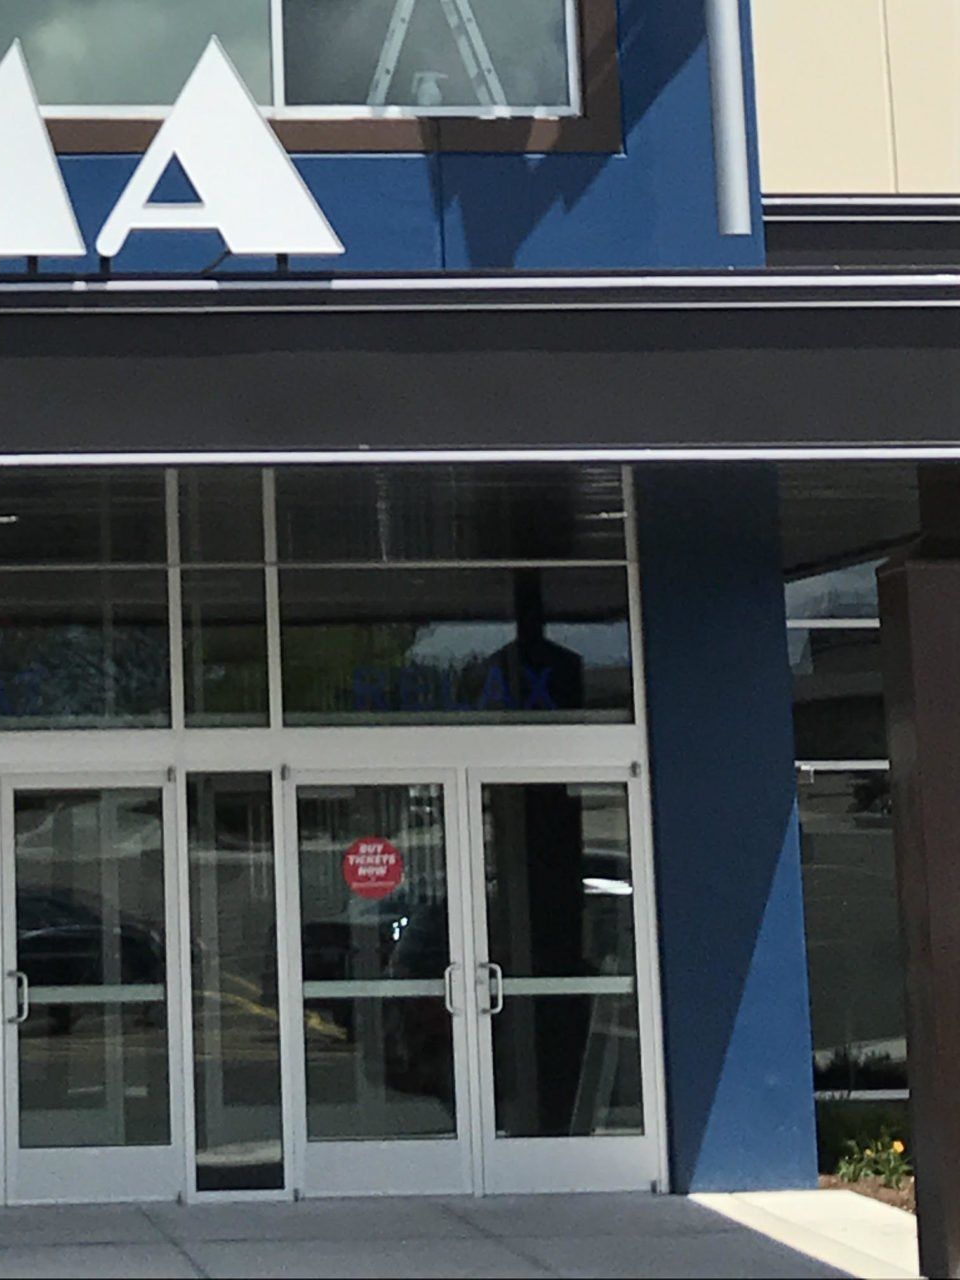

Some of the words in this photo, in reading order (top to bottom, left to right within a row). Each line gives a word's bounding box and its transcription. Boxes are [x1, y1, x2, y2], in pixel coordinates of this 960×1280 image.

[352, 667, 559, 711] RELAX
[358, 843, 384, 854] BUY
[346, 853, 396, 866] TICKETS
[358, 865, 388, 877] NOW
